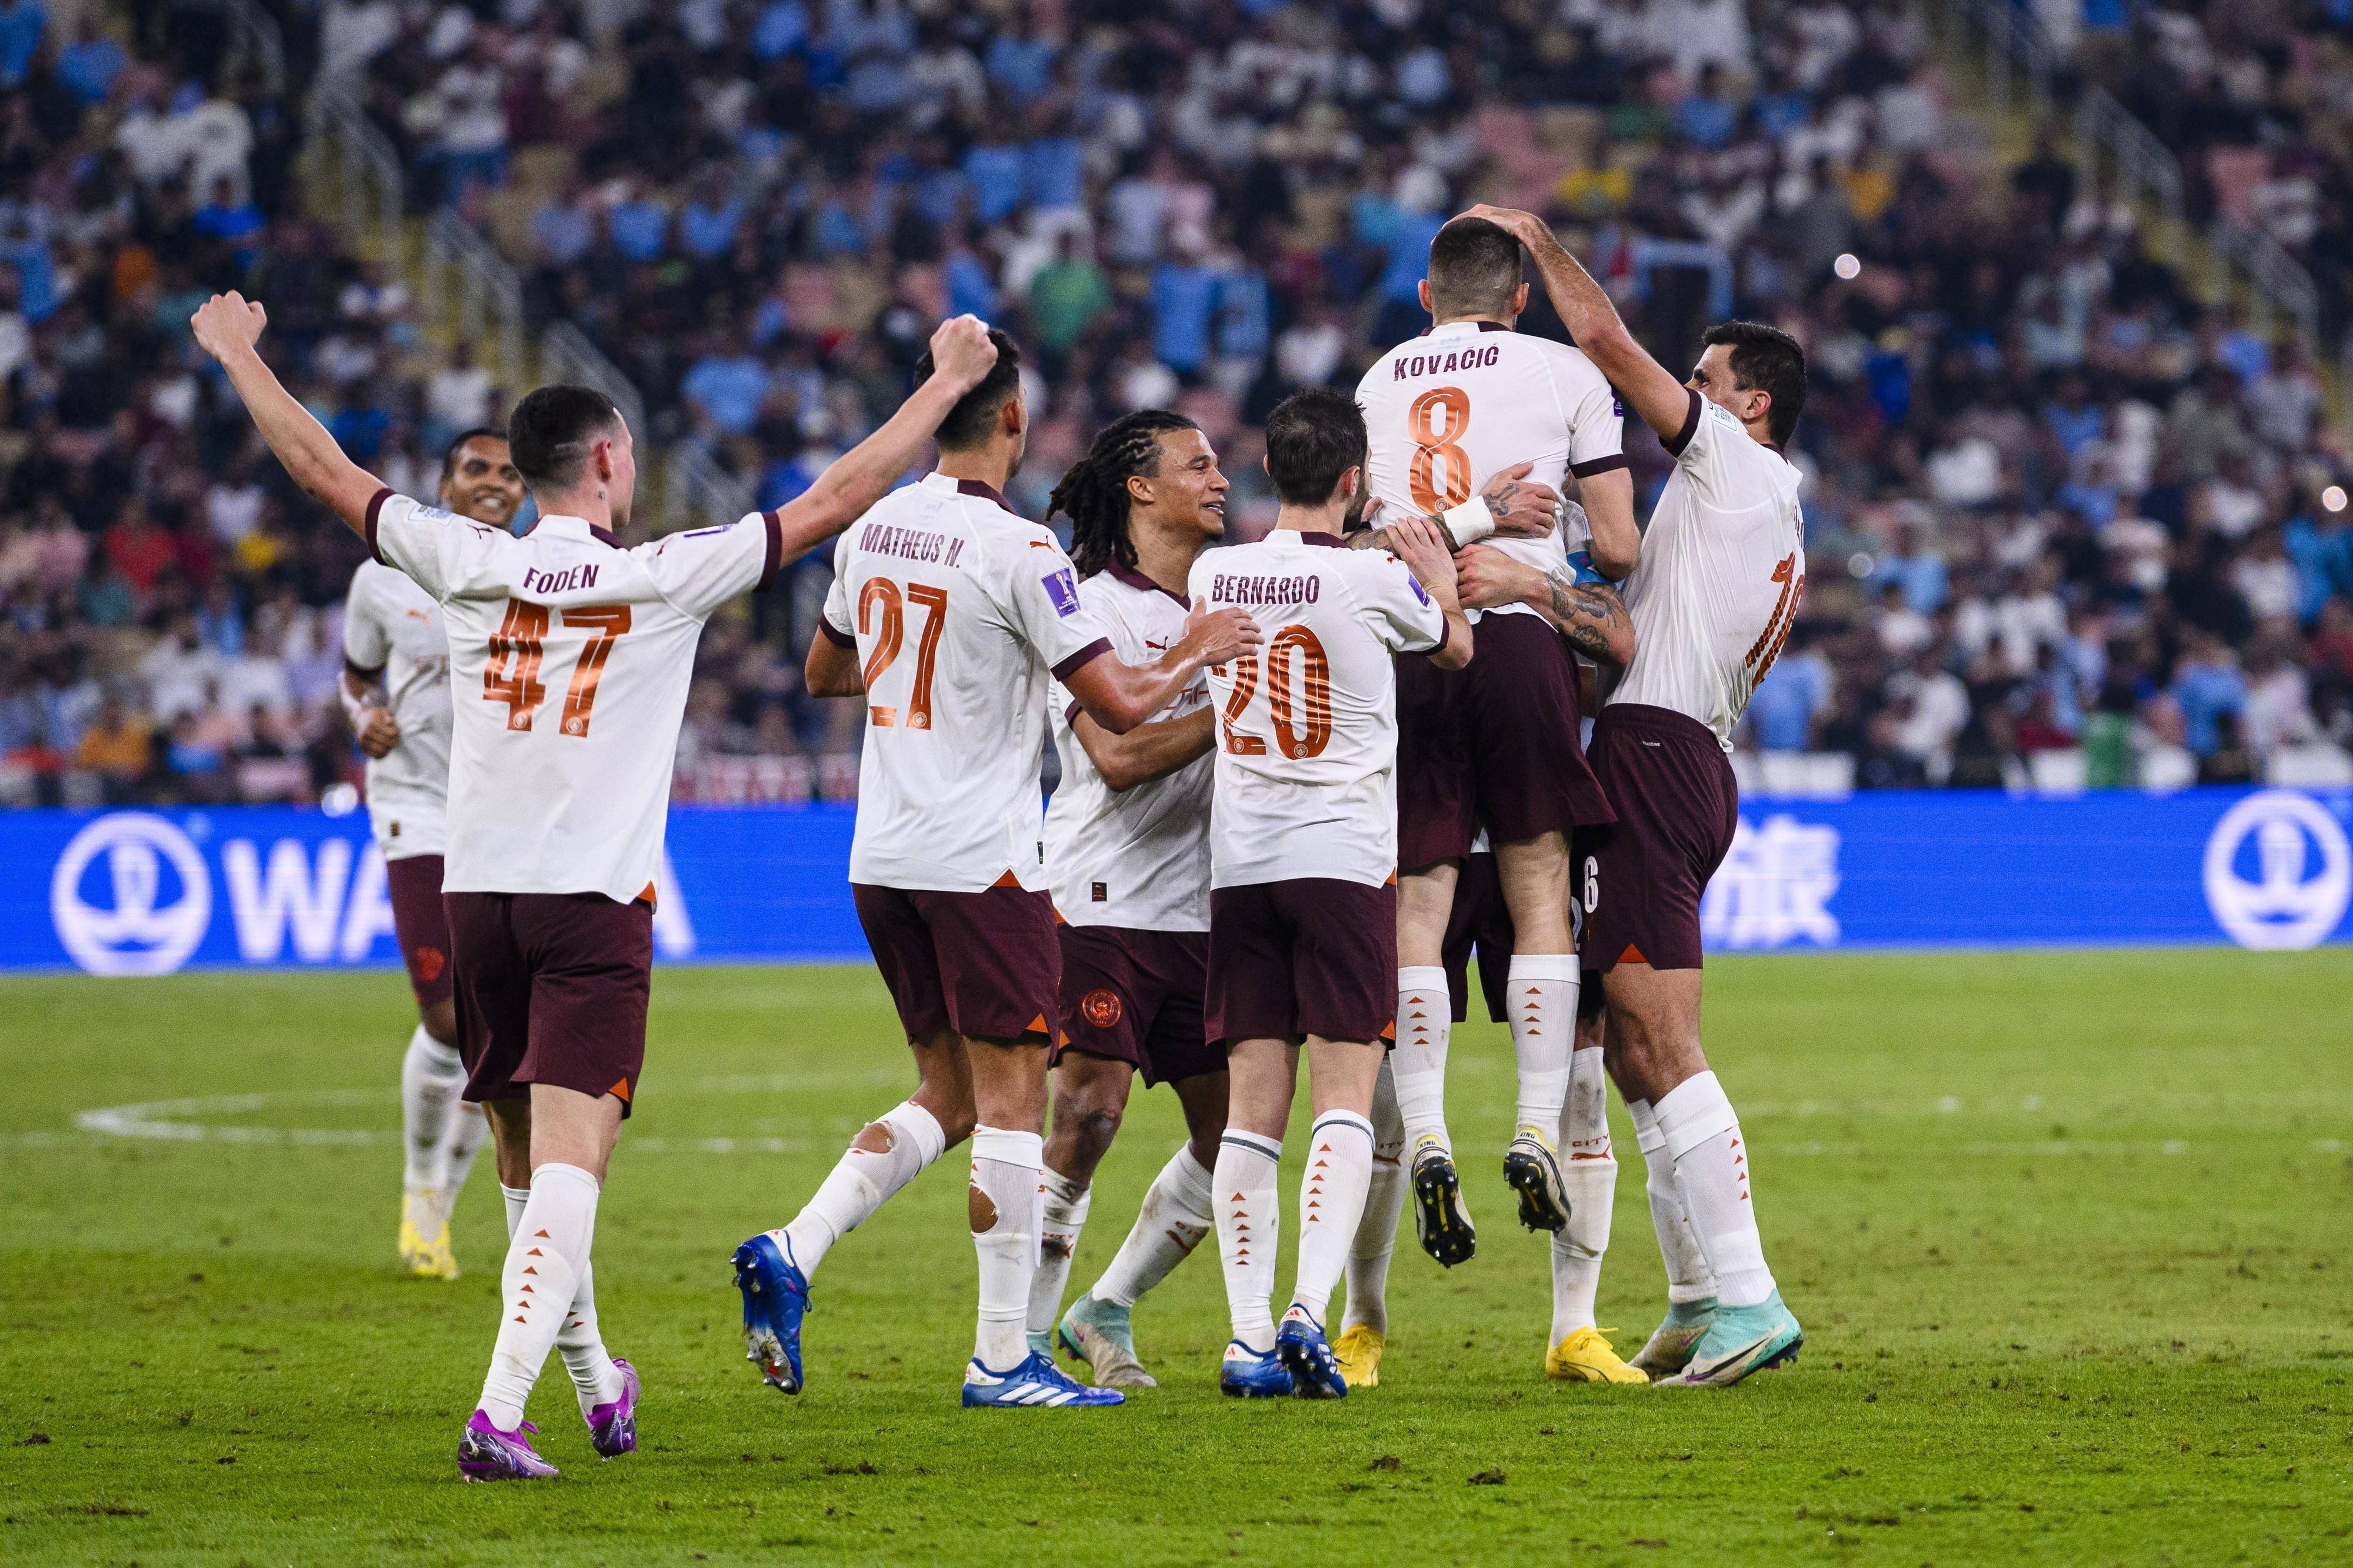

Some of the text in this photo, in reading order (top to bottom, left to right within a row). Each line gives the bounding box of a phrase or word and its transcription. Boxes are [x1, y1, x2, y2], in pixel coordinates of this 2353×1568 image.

[1394, 343, 1499, 381] KOVAČIĆ
[1408, 386, 1471, 515] 8
[859, 523, 965, 568] MATHEUS N.
[523, 564, 599, 594] FODEN
[1212, 574, 1319, 605] BERNARDO
[483, 599, 631, 737] 47
[858, 577, 947, 730] 27
[1210, 625, 1332, 760] 20
[1379, 1139, 1404, 1149] ITY
[1419, 1140, 1436, 1148] KING
[1519, 1131, 1535, 1139] KING
[1572, 1133, 1609, 1147] CITY
